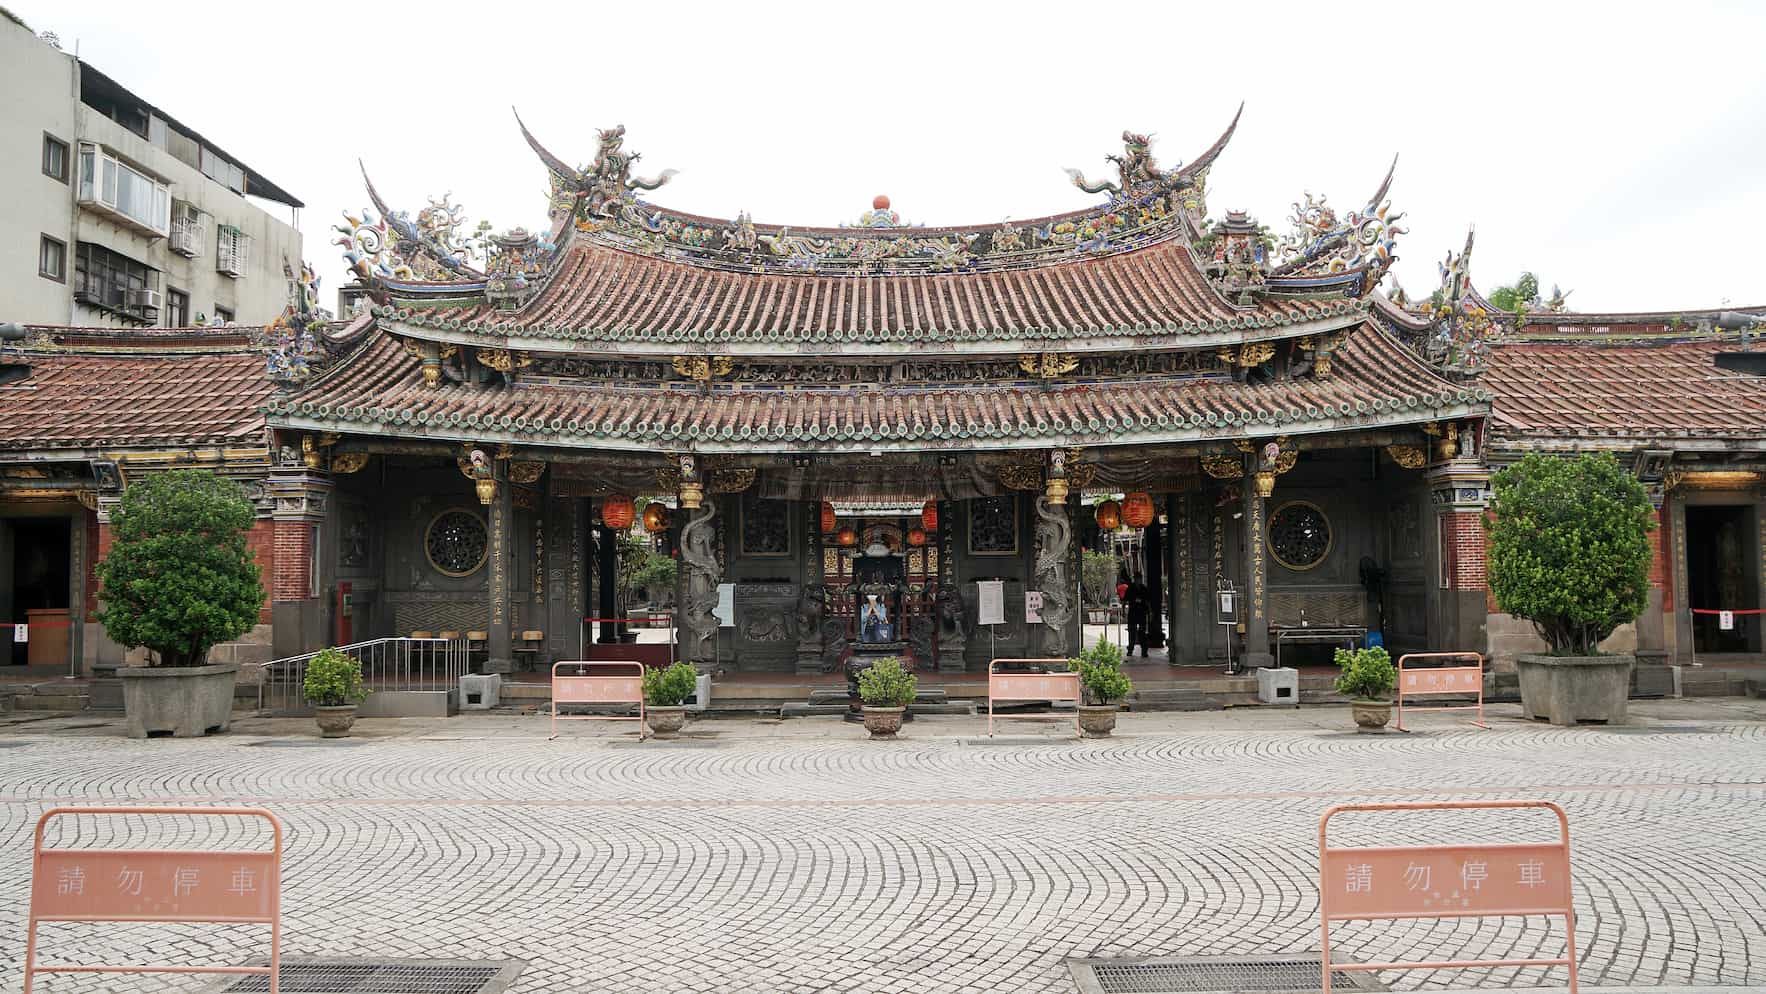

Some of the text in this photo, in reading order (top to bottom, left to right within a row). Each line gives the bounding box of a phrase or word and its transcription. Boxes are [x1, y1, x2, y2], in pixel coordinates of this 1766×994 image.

[56, 865, 257, 897] 請勿停車
[1345, 858, 1546, 893] 請勿停車
